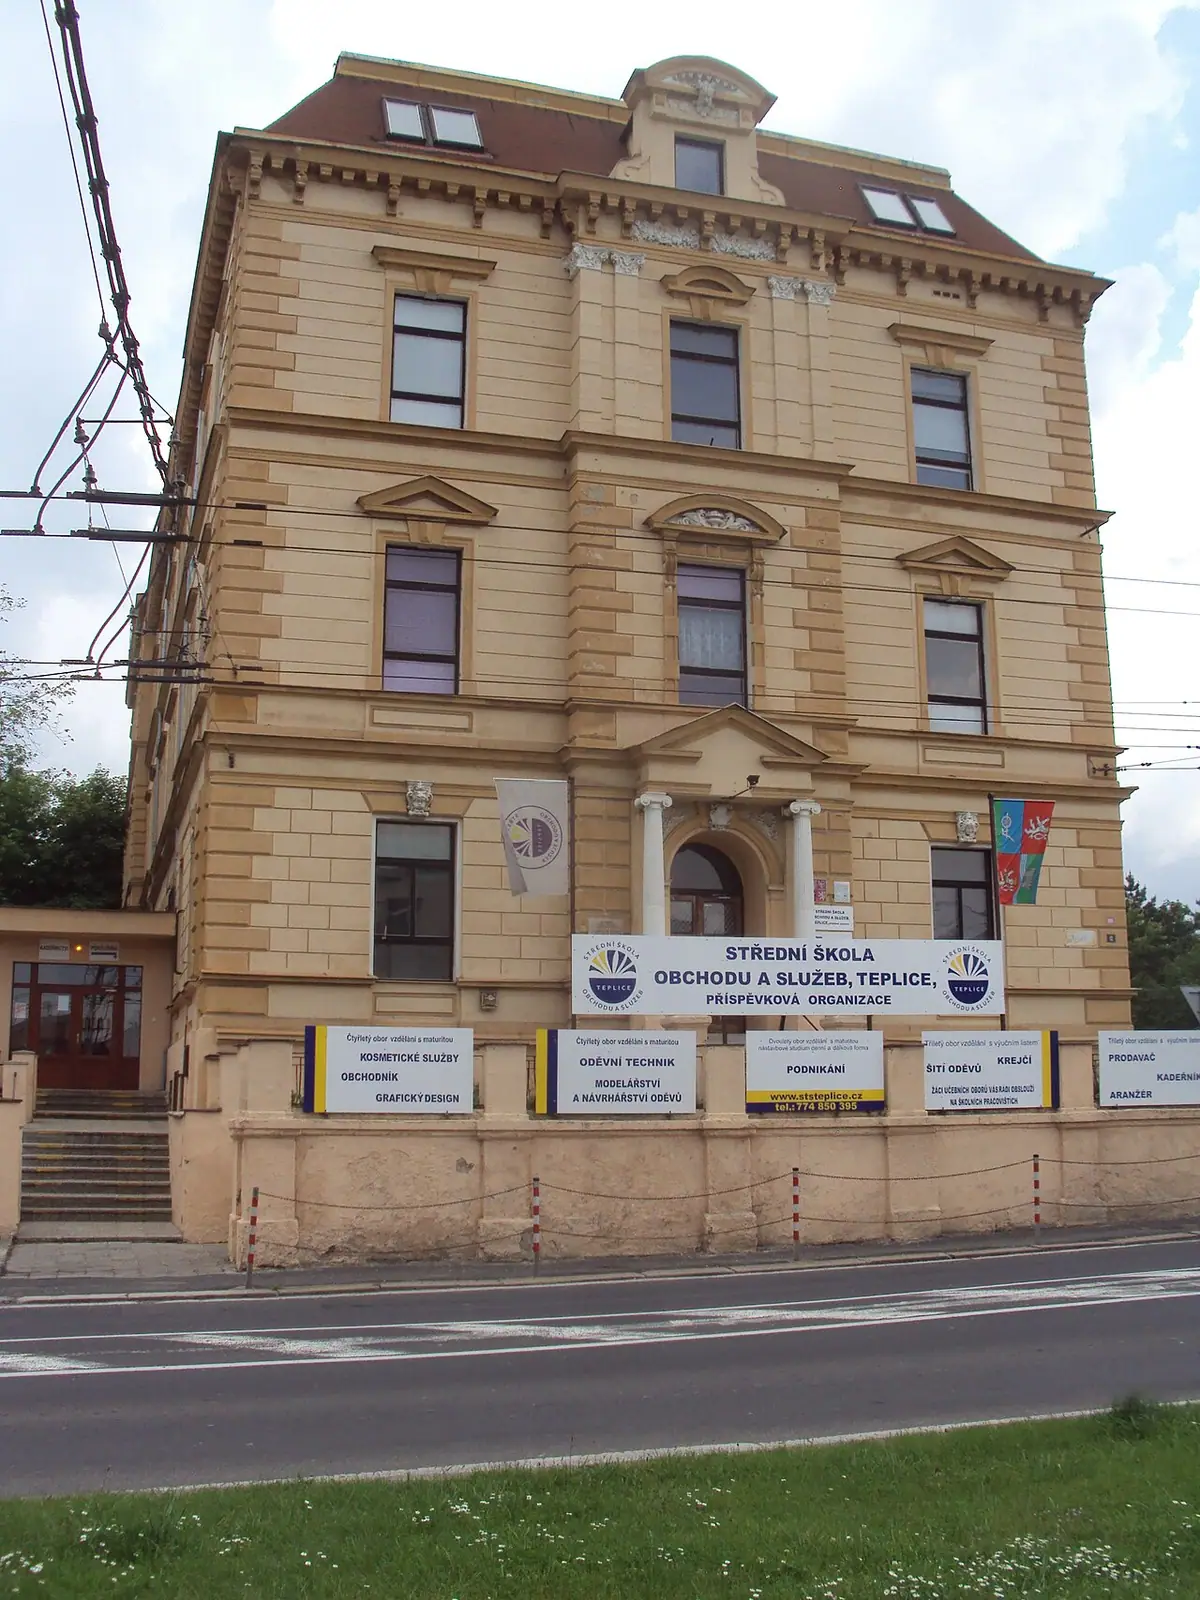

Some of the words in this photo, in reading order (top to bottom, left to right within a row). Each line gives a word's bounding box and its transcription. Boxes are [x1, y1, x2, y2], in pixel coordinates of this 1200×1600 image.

[726, 944, 807, 961] STŘEDNÍ
[813, 944, 875, 962] ŠKOLA
[654, 970, 751, 985] OBCHODU
[757, 972, 771, 986] A
[776, 969, 853, 989] SLUŽEB,
[856, 972, 937, 989] TEPLICE,
[706, 992, 800, 1005] PŘÍSPĚVKOVÁ
[808, 995, 892, 1005] ORGANIZACE
[650, 1038, 680, 1046] maturitou
[360, 1051, 420, 1062] KOSMETICKÉ
[422, 1052, 460, 1063] SLUŽBY
[579, 1056, 623, 1067] ODĚVNÍ
[626, 1058, 676, 1067] TECHNIK
[997, 1054, 1032, 1065] KREJČÍ
[1108, 1052, 1156, 1062] PRODAVAČ
[786, 1064, 846, 1074] PODNIKÁNÍ
[926, 1062, 946, 1074] ŠITÍ
[948, 1062, 982, 1074] ODĚVŮ
[341, 1070, 399, 1082] OBCHODNÍK
[595, 1077, 661, 1088] MODELÁŘSTVÍ
[375, 1092, 424, 1103] GRAFICKÝ
[424, 1094, 460, 1103] DESIGN
[572, 1094, 580, 1103] A
[582, 1092, 649, 1103] NÁVRHÁŘSTVÍ
[650, 1092, 682, 1103] ODĚVŮ
[770, 1092, 864, 1102] www.ststeplice.cz
[1110, 1088, 1152, 1099] ARANŽÉR
[796, 1102, 815, 1111] 774
[818, 1102, 836, 1110] 850
[839, 1102, 858, 1110] 395
[950, 1098, 958, 1106] NA
